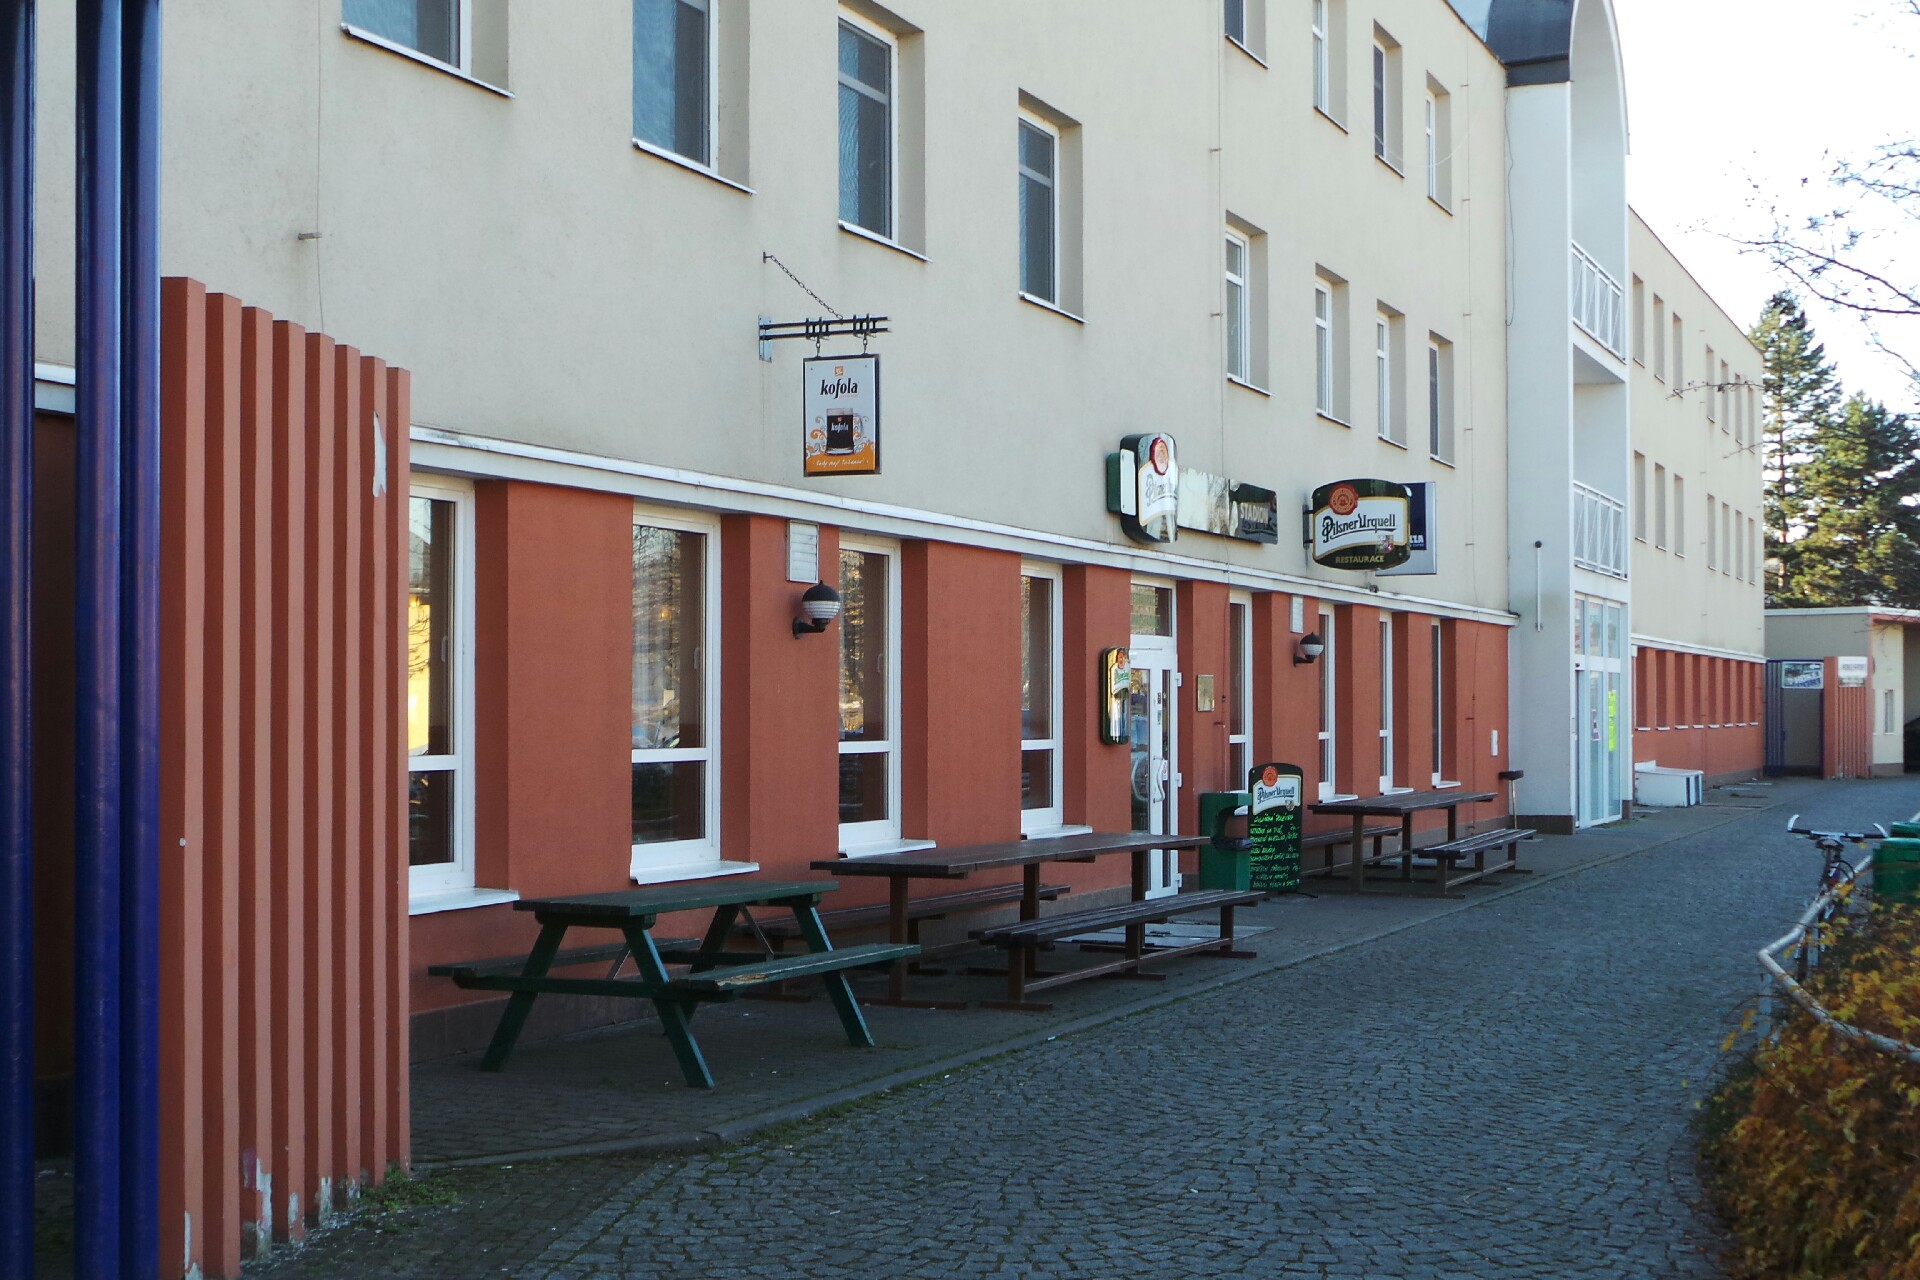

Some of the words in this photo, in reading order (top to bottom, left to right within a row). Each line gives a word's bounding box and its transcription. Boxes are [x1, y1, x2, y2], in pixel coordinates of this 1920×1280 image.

[820, 377, 858, 399] kofola
[1240, 502, 1269, 525] STADION
[1322, 515, 1359, 543] Pilsner
[1358, 513, 1396, 533] Urquell
[1335, 555, 1384, 564] RESTAURACE
[1257, 787, 1277, 805] Pilsner
[1276, 786, 1294, 798] Urquell
